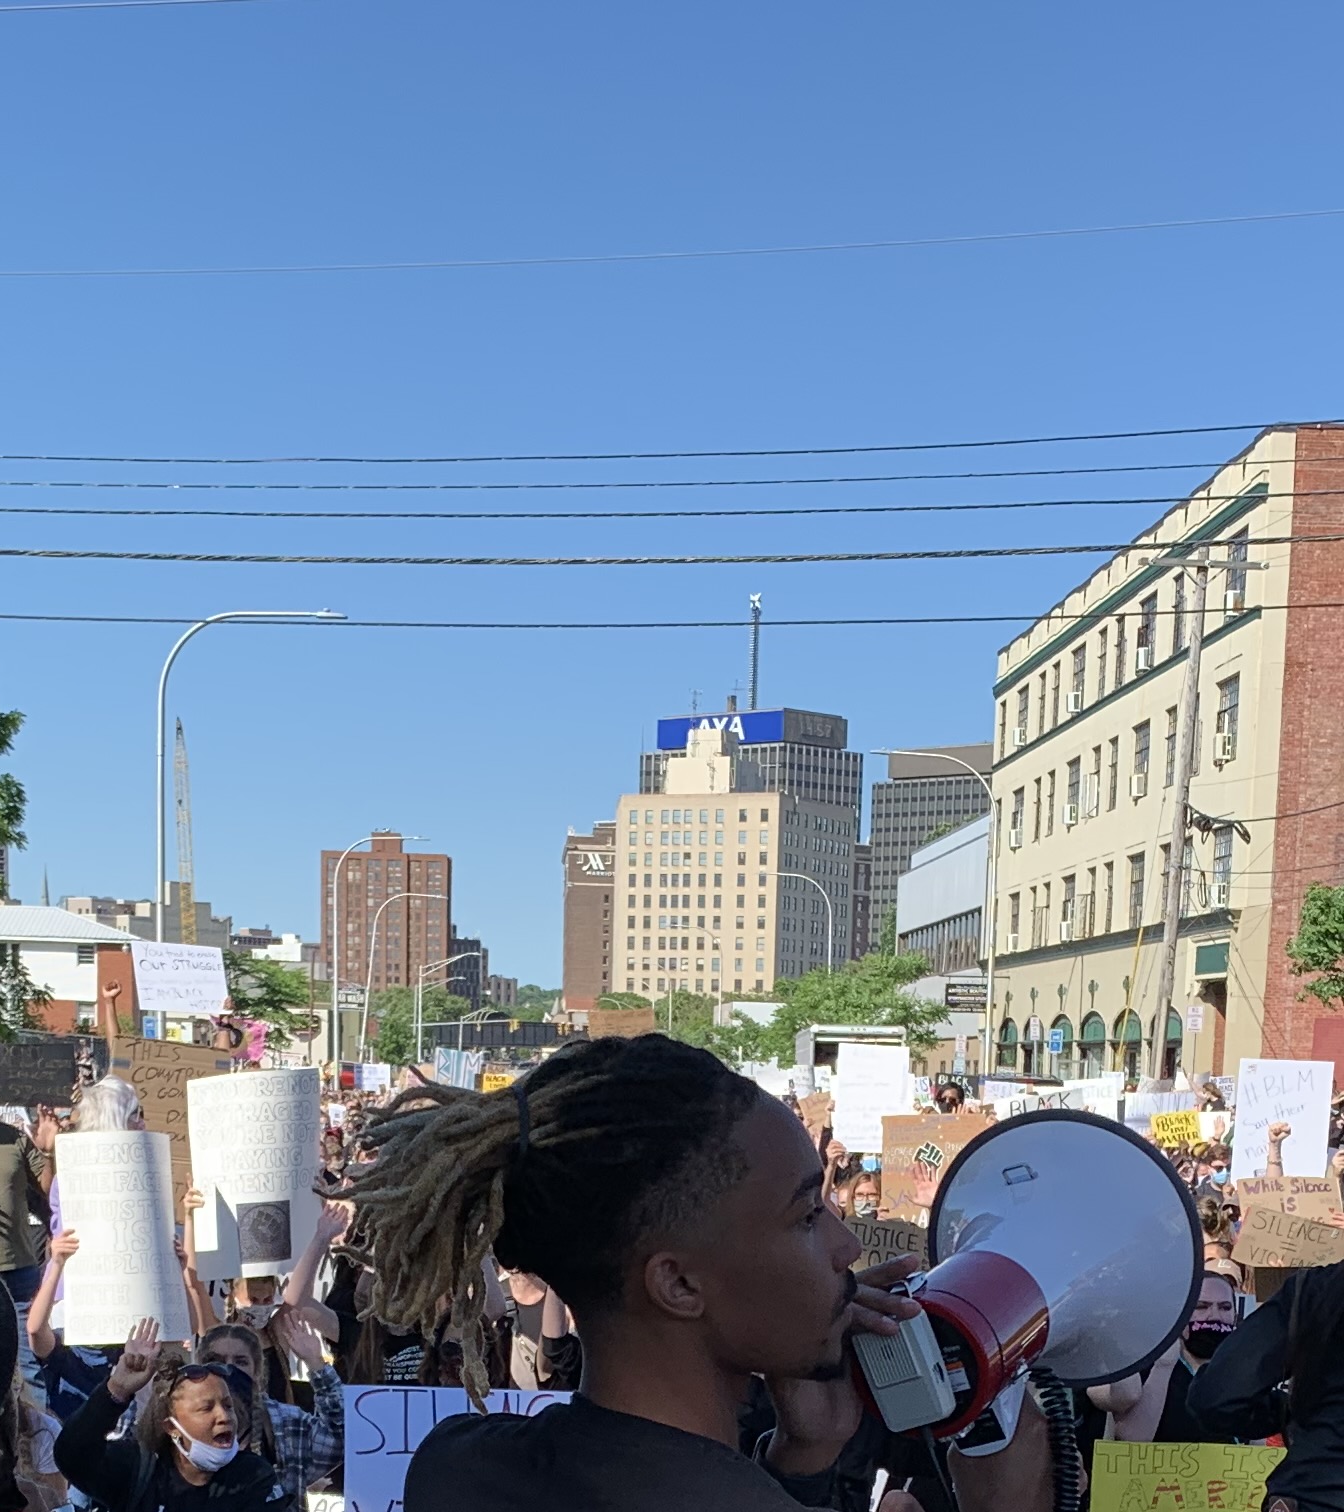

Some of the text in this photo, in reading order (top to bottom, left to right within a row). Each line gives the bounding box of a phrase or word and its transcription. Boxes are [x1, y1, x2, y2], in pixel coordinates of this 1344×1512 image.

[124, 1041, 183, 1062] THIS
[282, 1123, 317, 1143] NOT
[221, 1146, 304, 1172] PAYING
[1243, 1179, 1332, 1196] White Silence
[852, 1221, 919, 1253] JUSTICE
[1252, 1210, 1331, 1246] SILENCE
[1095, 1441, 1279, 1482] THIS IS
[1118, 1477, 1264, 1512] AMERIC
